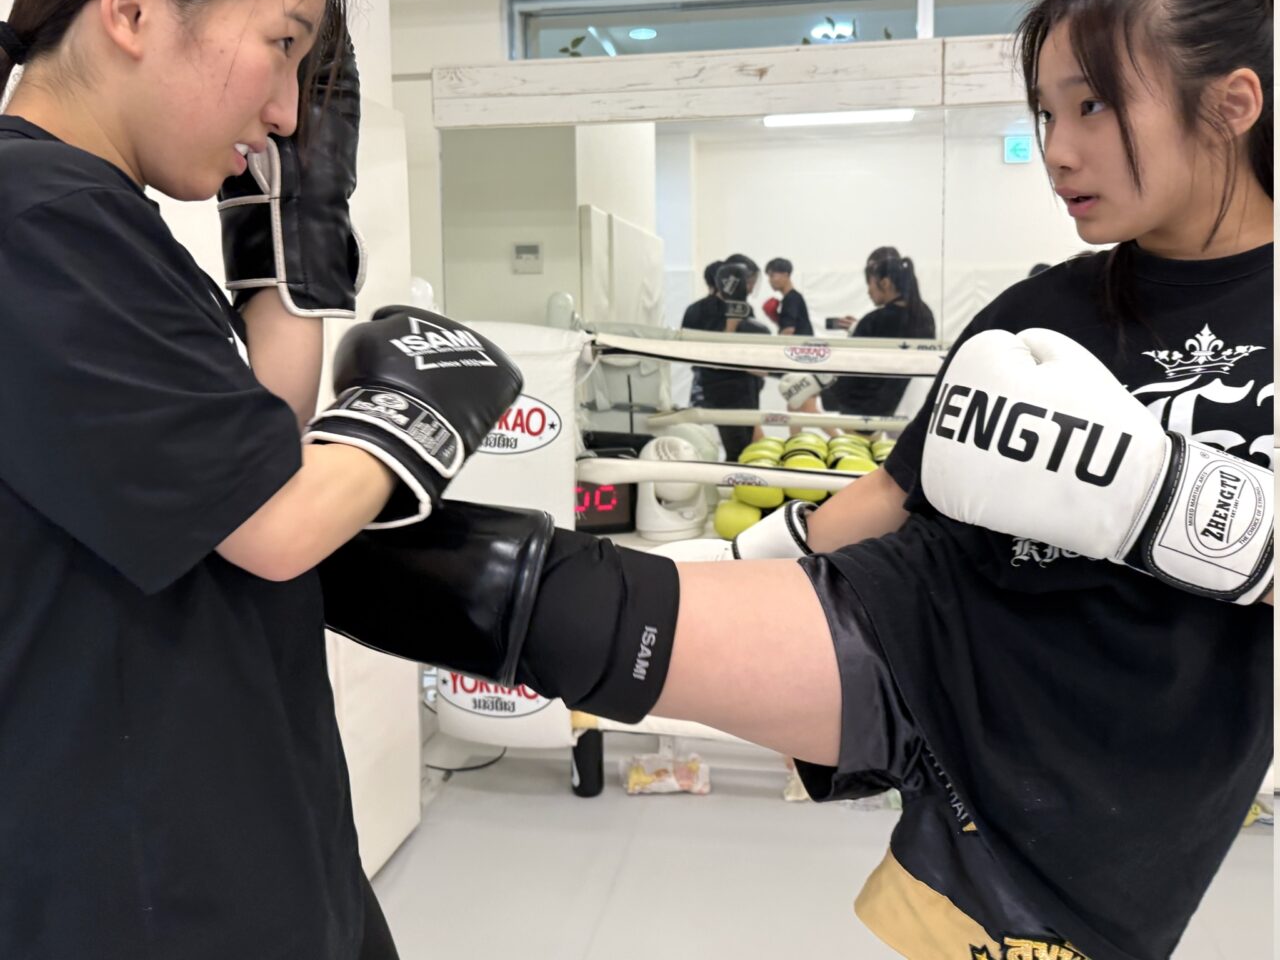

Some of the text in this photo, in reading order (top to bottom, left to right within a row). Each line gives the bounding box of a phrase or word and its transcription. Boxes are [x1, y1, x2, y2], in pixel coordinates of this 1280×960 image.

[389, 329, 484, 355] ISAMI
[497, 406, 547, 437] KAO
[1200, 470, 1242, 542] ZHENGTU
[632, 625, 658, 680] ISAMI
